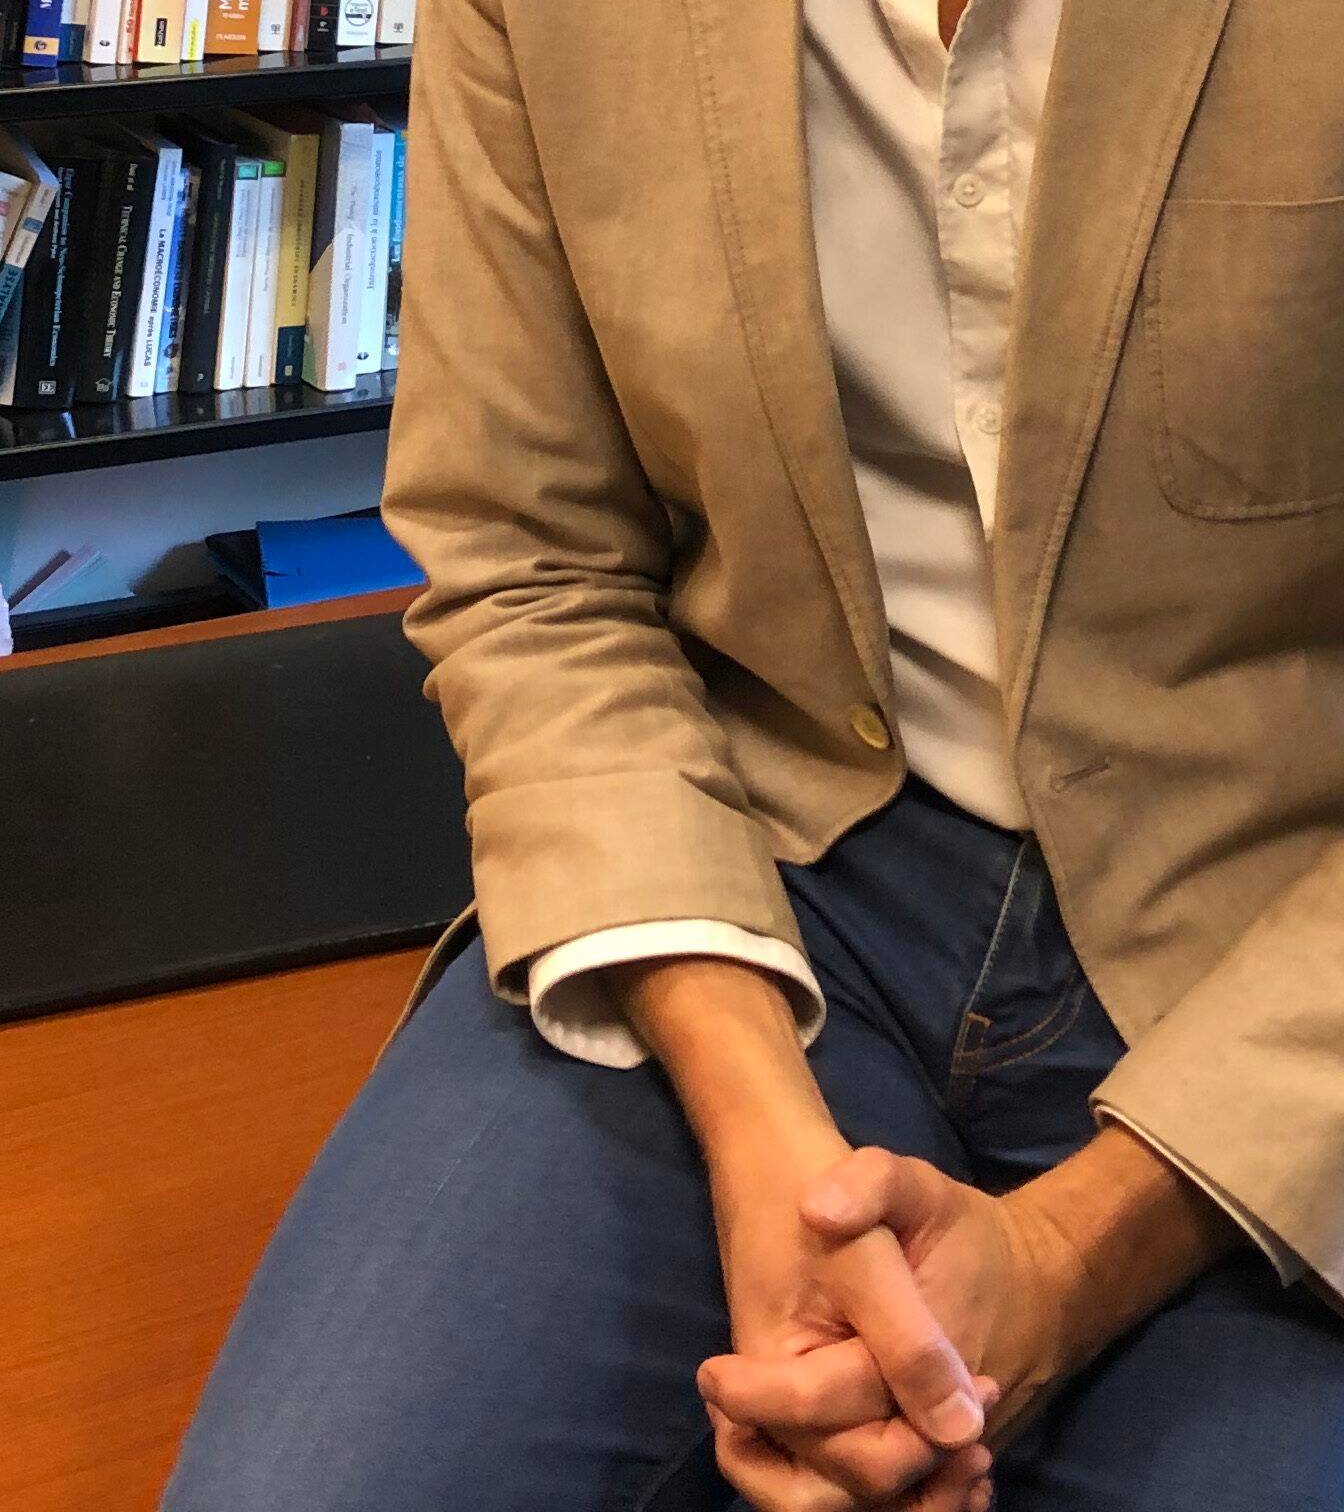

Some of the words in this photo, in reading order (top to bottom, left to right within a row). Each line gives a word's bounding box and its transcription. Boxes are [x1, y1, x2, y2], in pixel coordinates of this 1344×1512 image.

[158, 228, 167, 239] La
[368, 217, 378, 226] la
[113, 245, 127, 273] CHANGE
[344, 234, 353, 272] Industrial
[366, 236, 378, 290] Introduction
[112, 276, 122, 289] AND
[150, 240, 167, 314] MACROÉCONOMIE
[107, 291, 121, 328] ECONOMIC
[341, 273, 351, 324] Organization
[103, 330, 117, 358] THEORY
[143, 339, 152, 367] LUCAS
